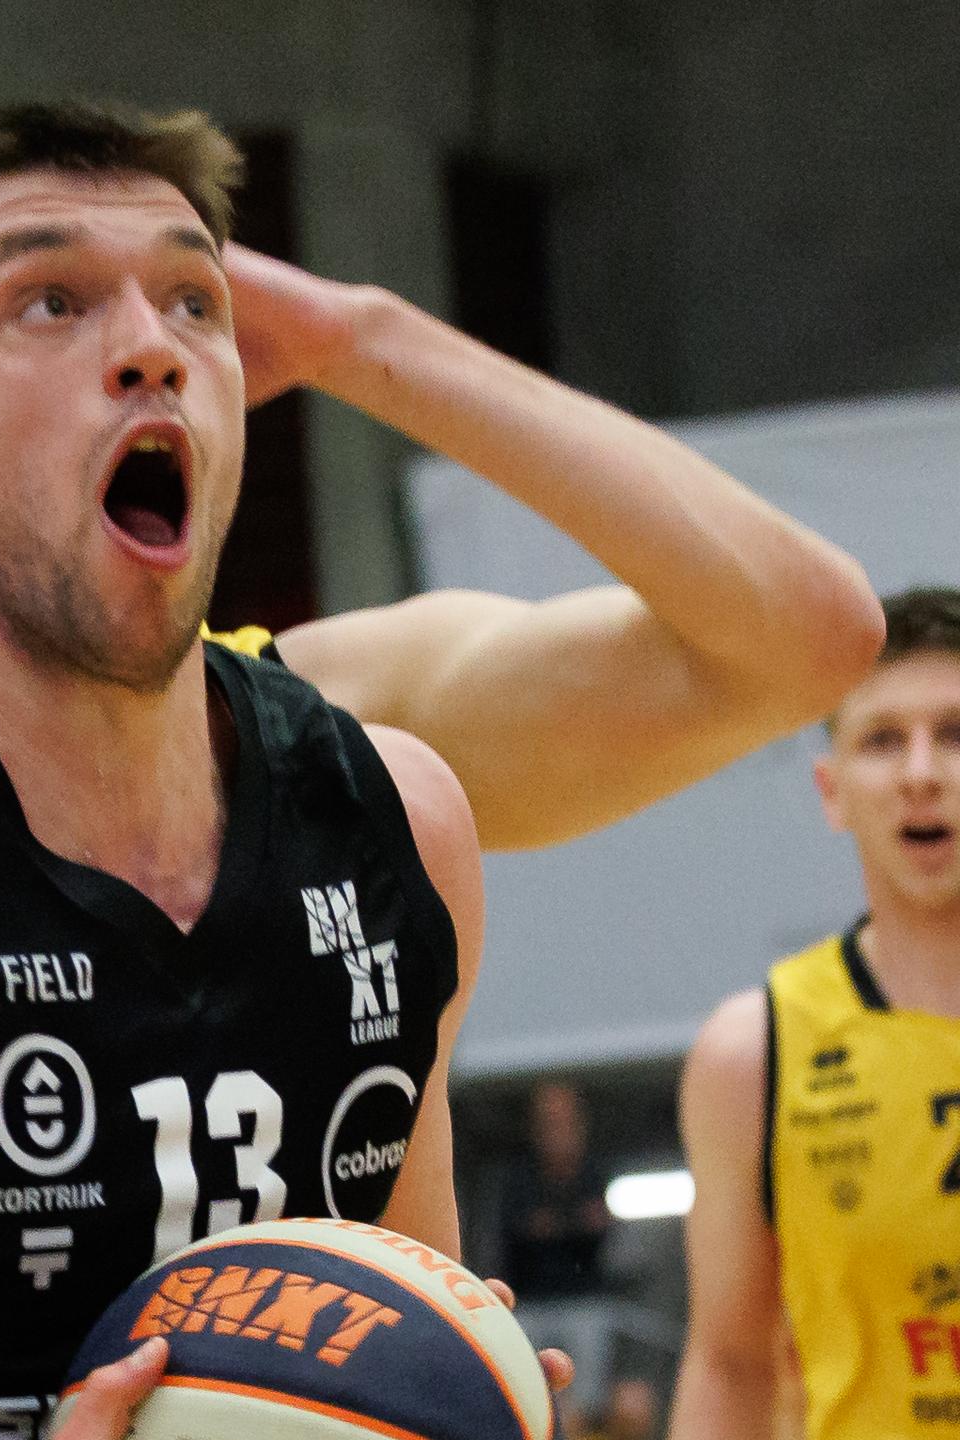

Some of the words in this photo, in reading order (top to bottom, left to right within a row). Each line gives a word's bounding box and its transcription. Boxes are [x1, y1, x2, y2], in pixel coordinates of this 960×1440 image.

[350, 1014, 401, 1045] LEAGUE
[131, 1070, 287, 1274] 13
[129, 1264, 403, 1368] BNXT
